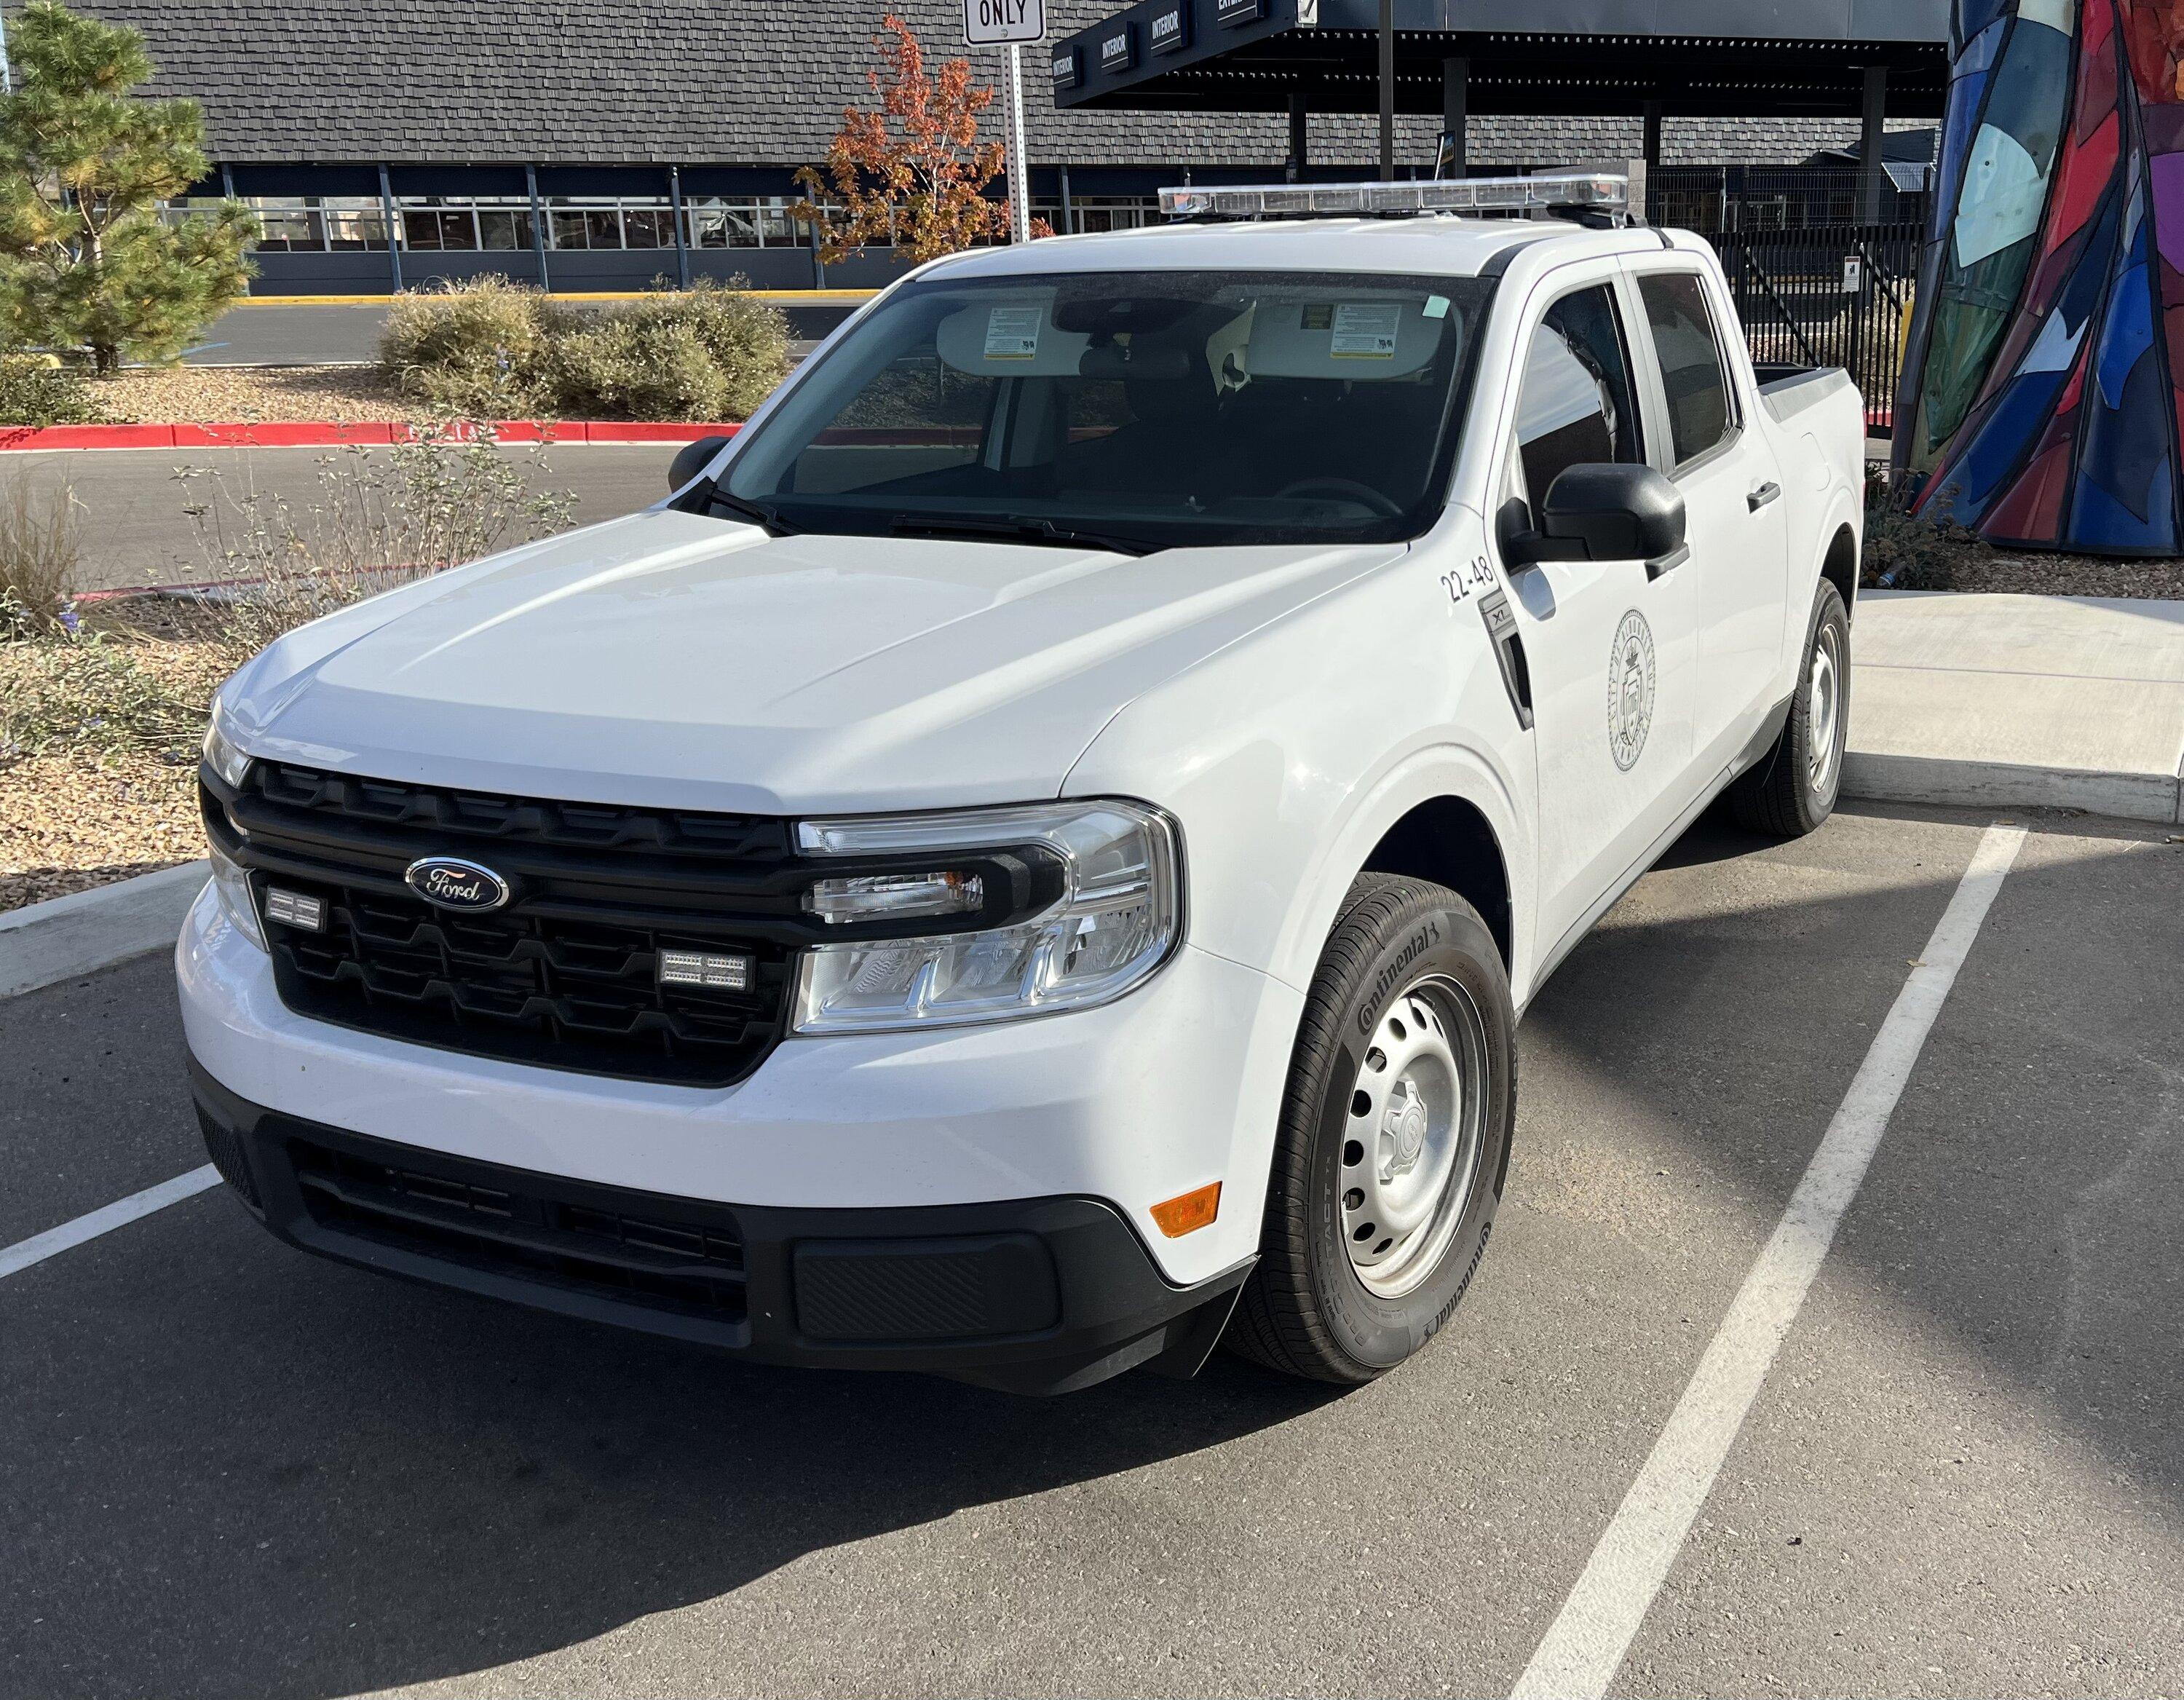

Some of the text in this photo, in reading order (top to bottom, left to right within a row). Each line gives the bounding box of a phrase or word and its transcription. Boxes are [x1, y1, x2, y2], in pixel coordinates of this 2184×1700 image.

[979, 0, 1026, 26] ONLY
[1152, 10, 1179, 40] INTERIOR
[1102, 33, 1126, 59] INTERIOR
[1053, 55, 1073, 76] INTERIOR
[1441, 556, 1493, 604] 22-48
[426, 868, 481, 901] Ford
[1357, 925, 1429, 1036] Continental
